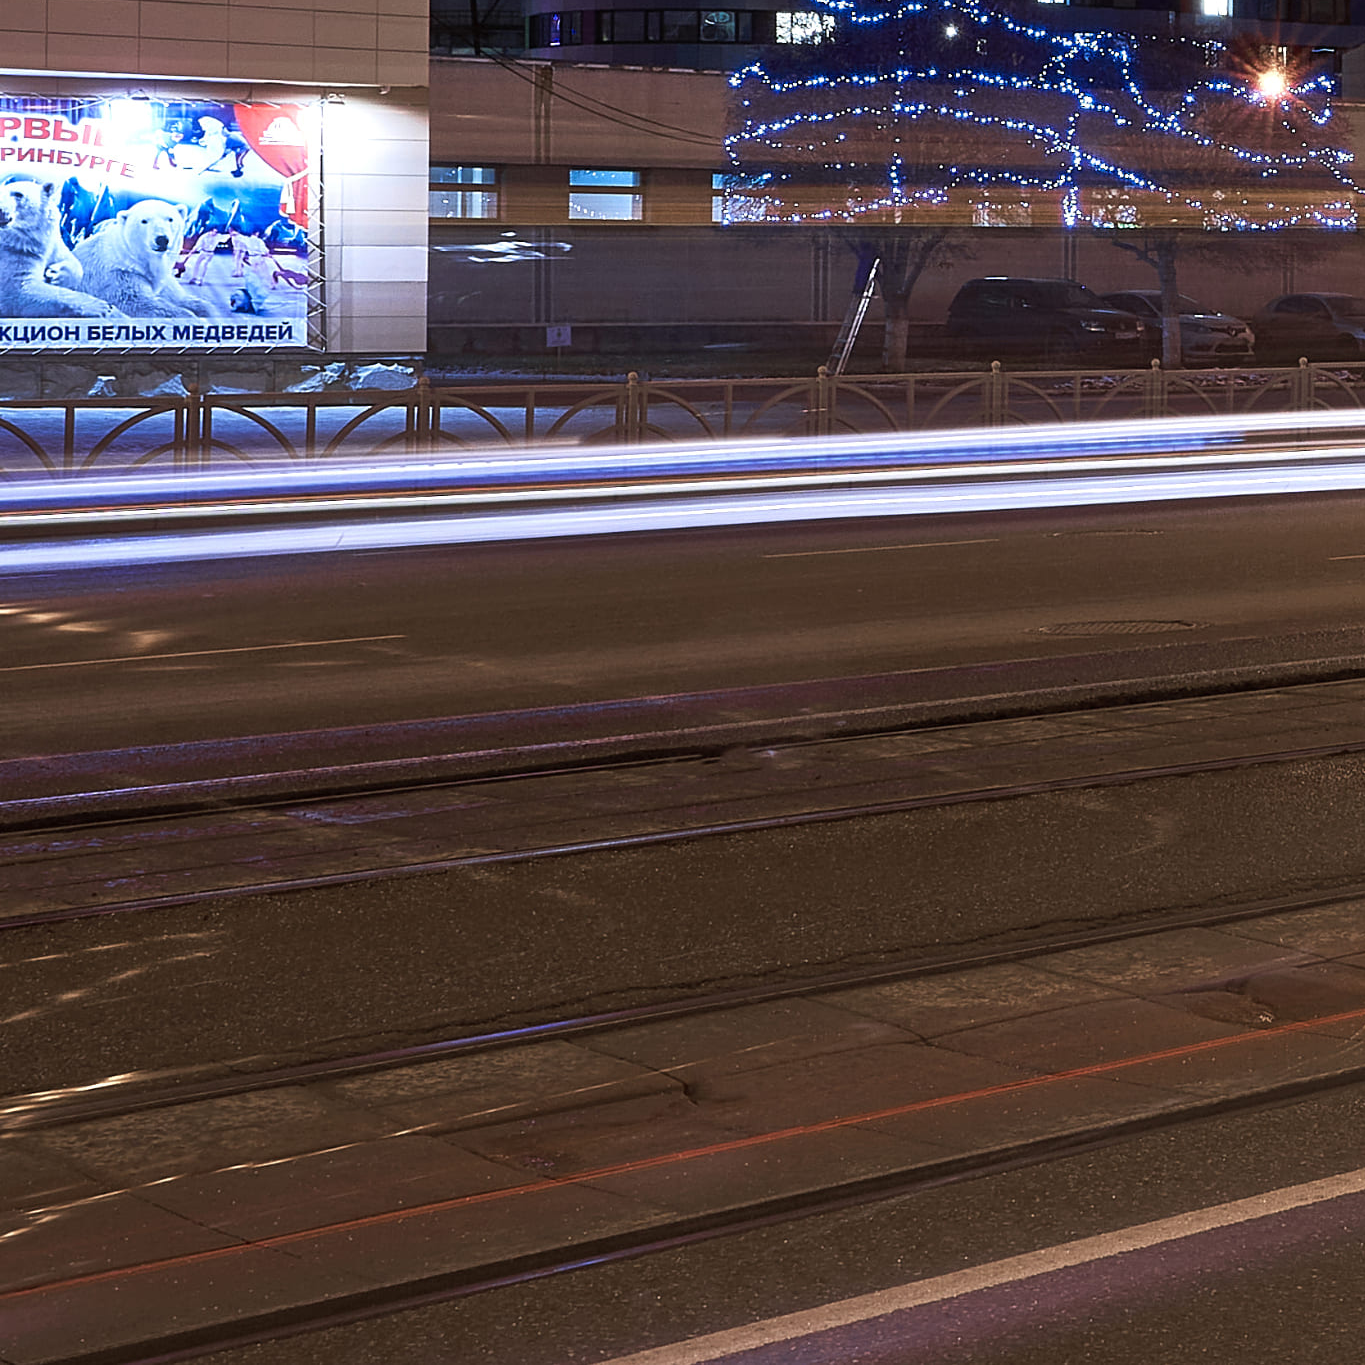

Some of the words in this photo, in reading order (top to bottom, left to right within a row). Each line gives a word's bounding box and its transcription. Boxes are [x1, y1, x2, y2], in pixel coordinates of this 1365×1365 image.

[1, 147, 135, 178] РИНБУРГЕ
[87, 325, 166, 341] БЕЛЫХ
[172, 322, 293, 342] МЕДВЕДЕЙ
